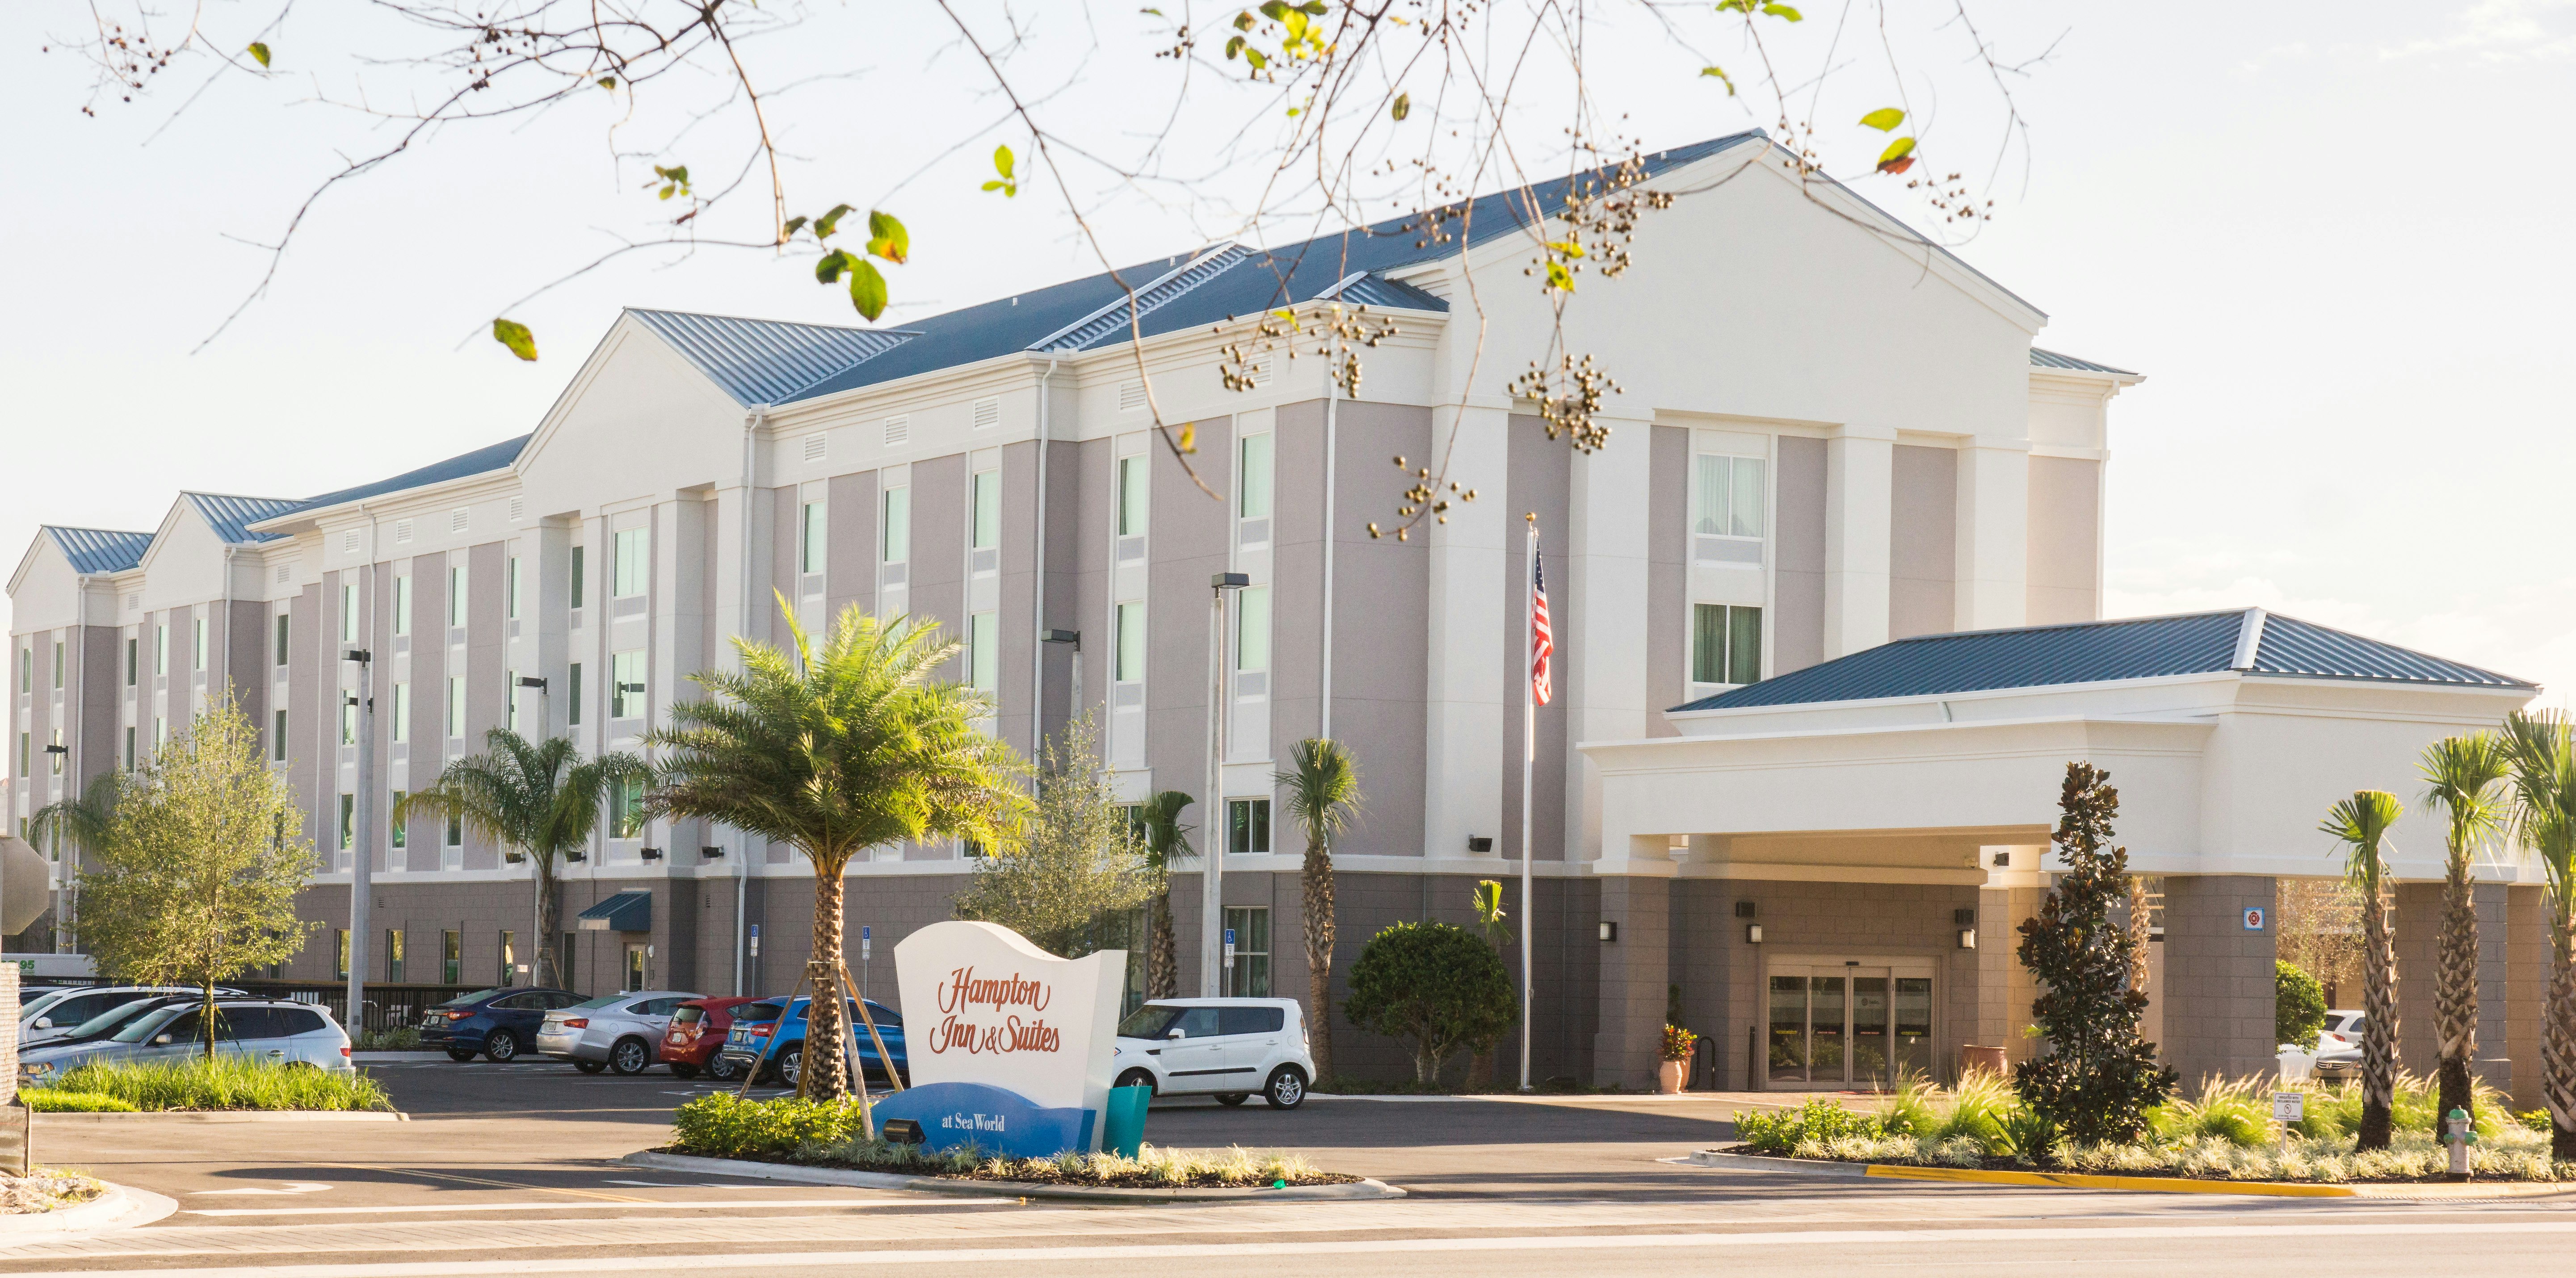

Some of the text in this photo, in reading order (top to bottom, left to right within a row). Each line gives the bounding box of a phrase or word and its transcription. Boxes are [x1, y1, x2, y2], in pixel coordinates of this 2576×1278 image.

[938, 966, 1050, 1014] Hampton
[930, 1015, 1059, 1055] Inn & Suites
[942, 1115, 953, 1128] at
